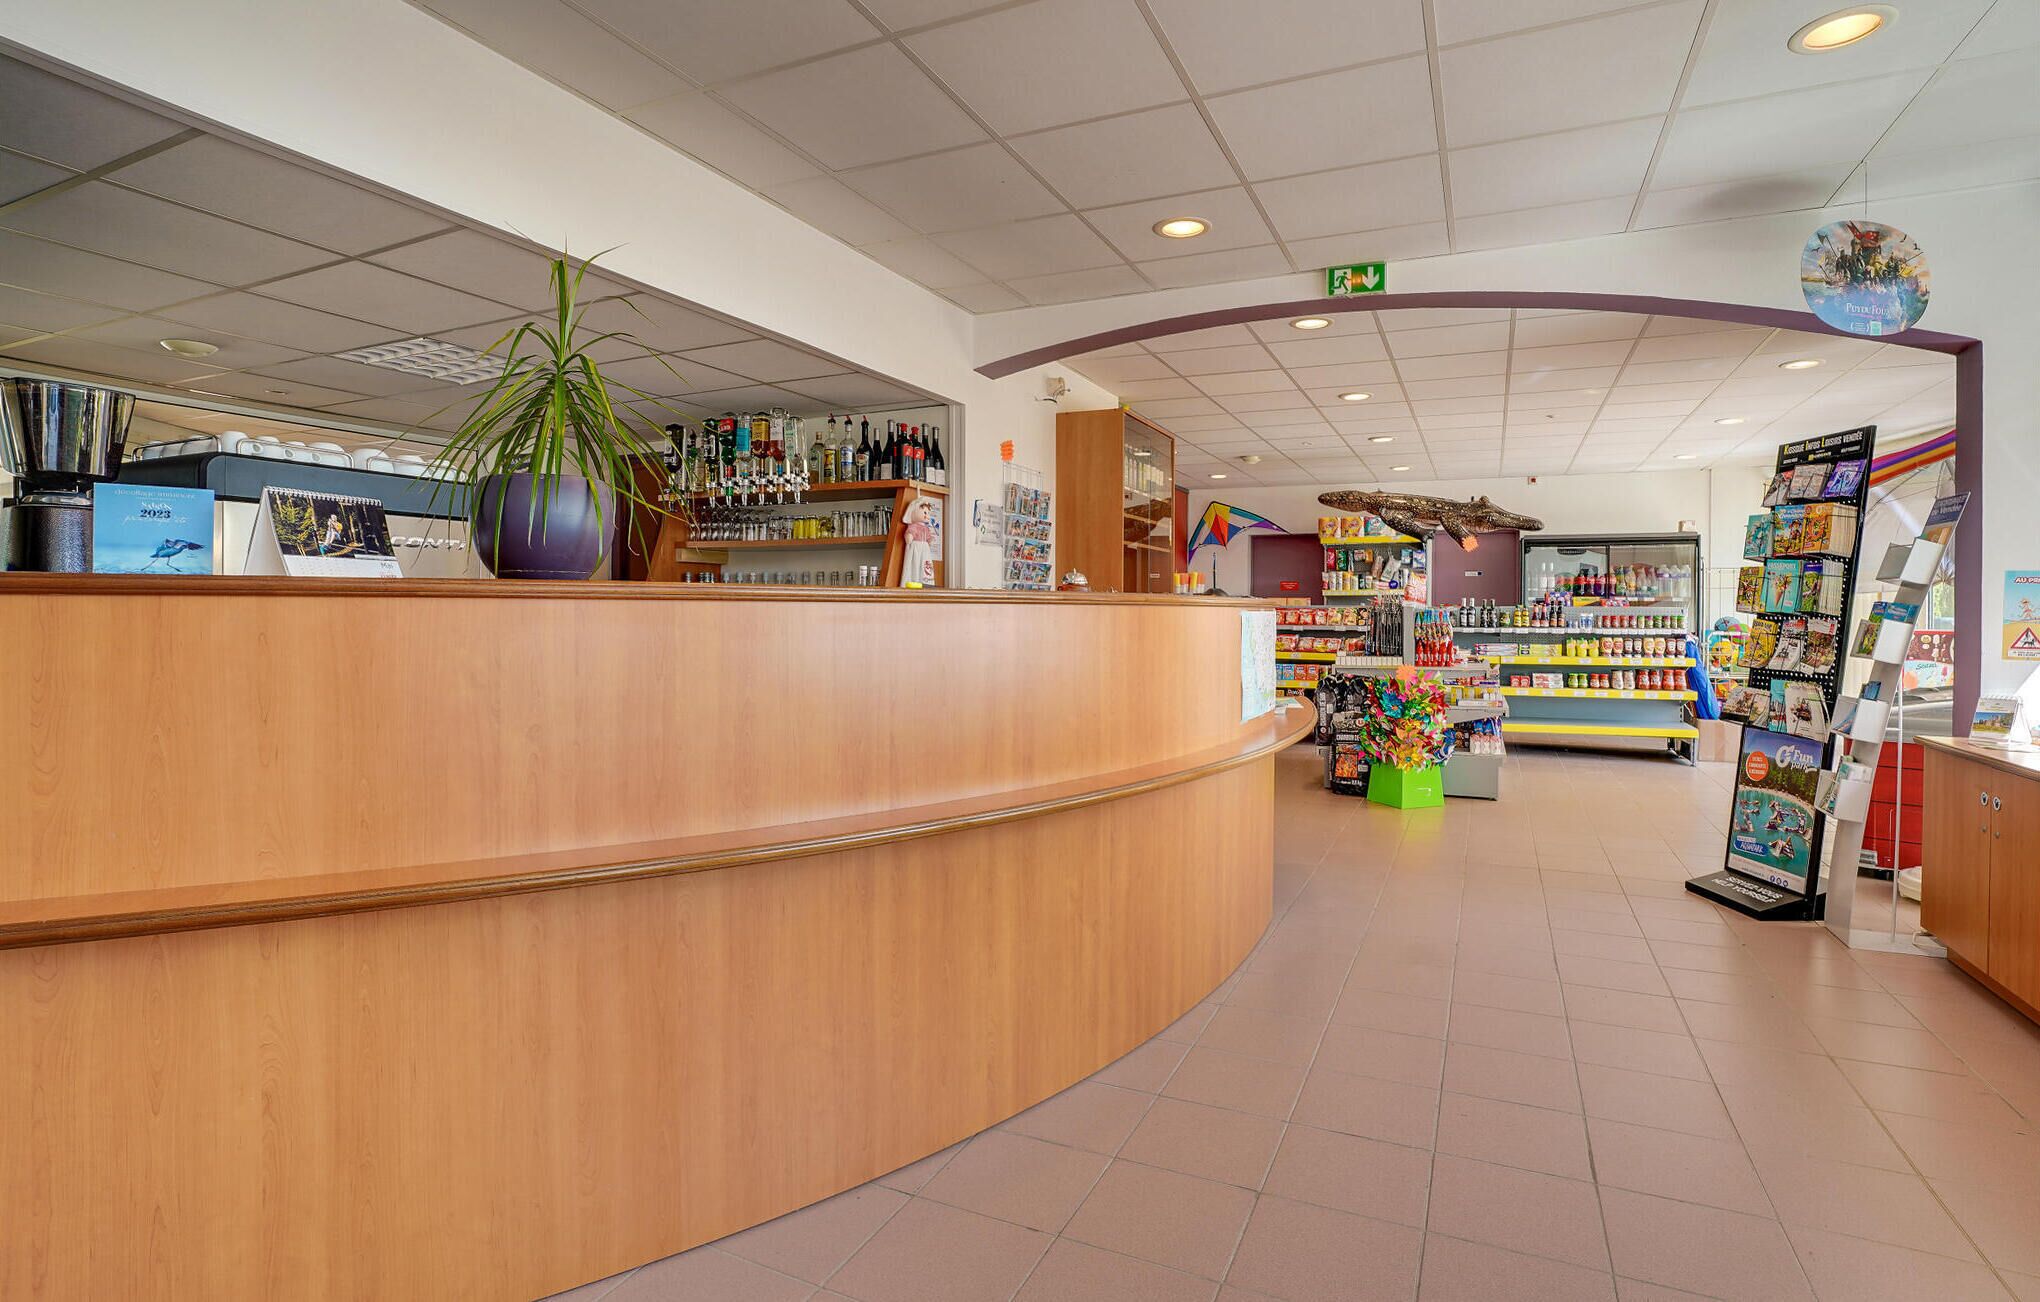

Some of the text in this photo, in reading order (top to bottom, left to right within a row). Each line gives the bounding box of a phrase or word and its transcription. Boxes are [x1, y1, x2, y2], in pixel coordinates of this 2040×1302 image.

[1805, 440, 1820, 451] INFOS
[140, 509, 171, 519] 2023
[1792, 750, 1813, 764] Fun
